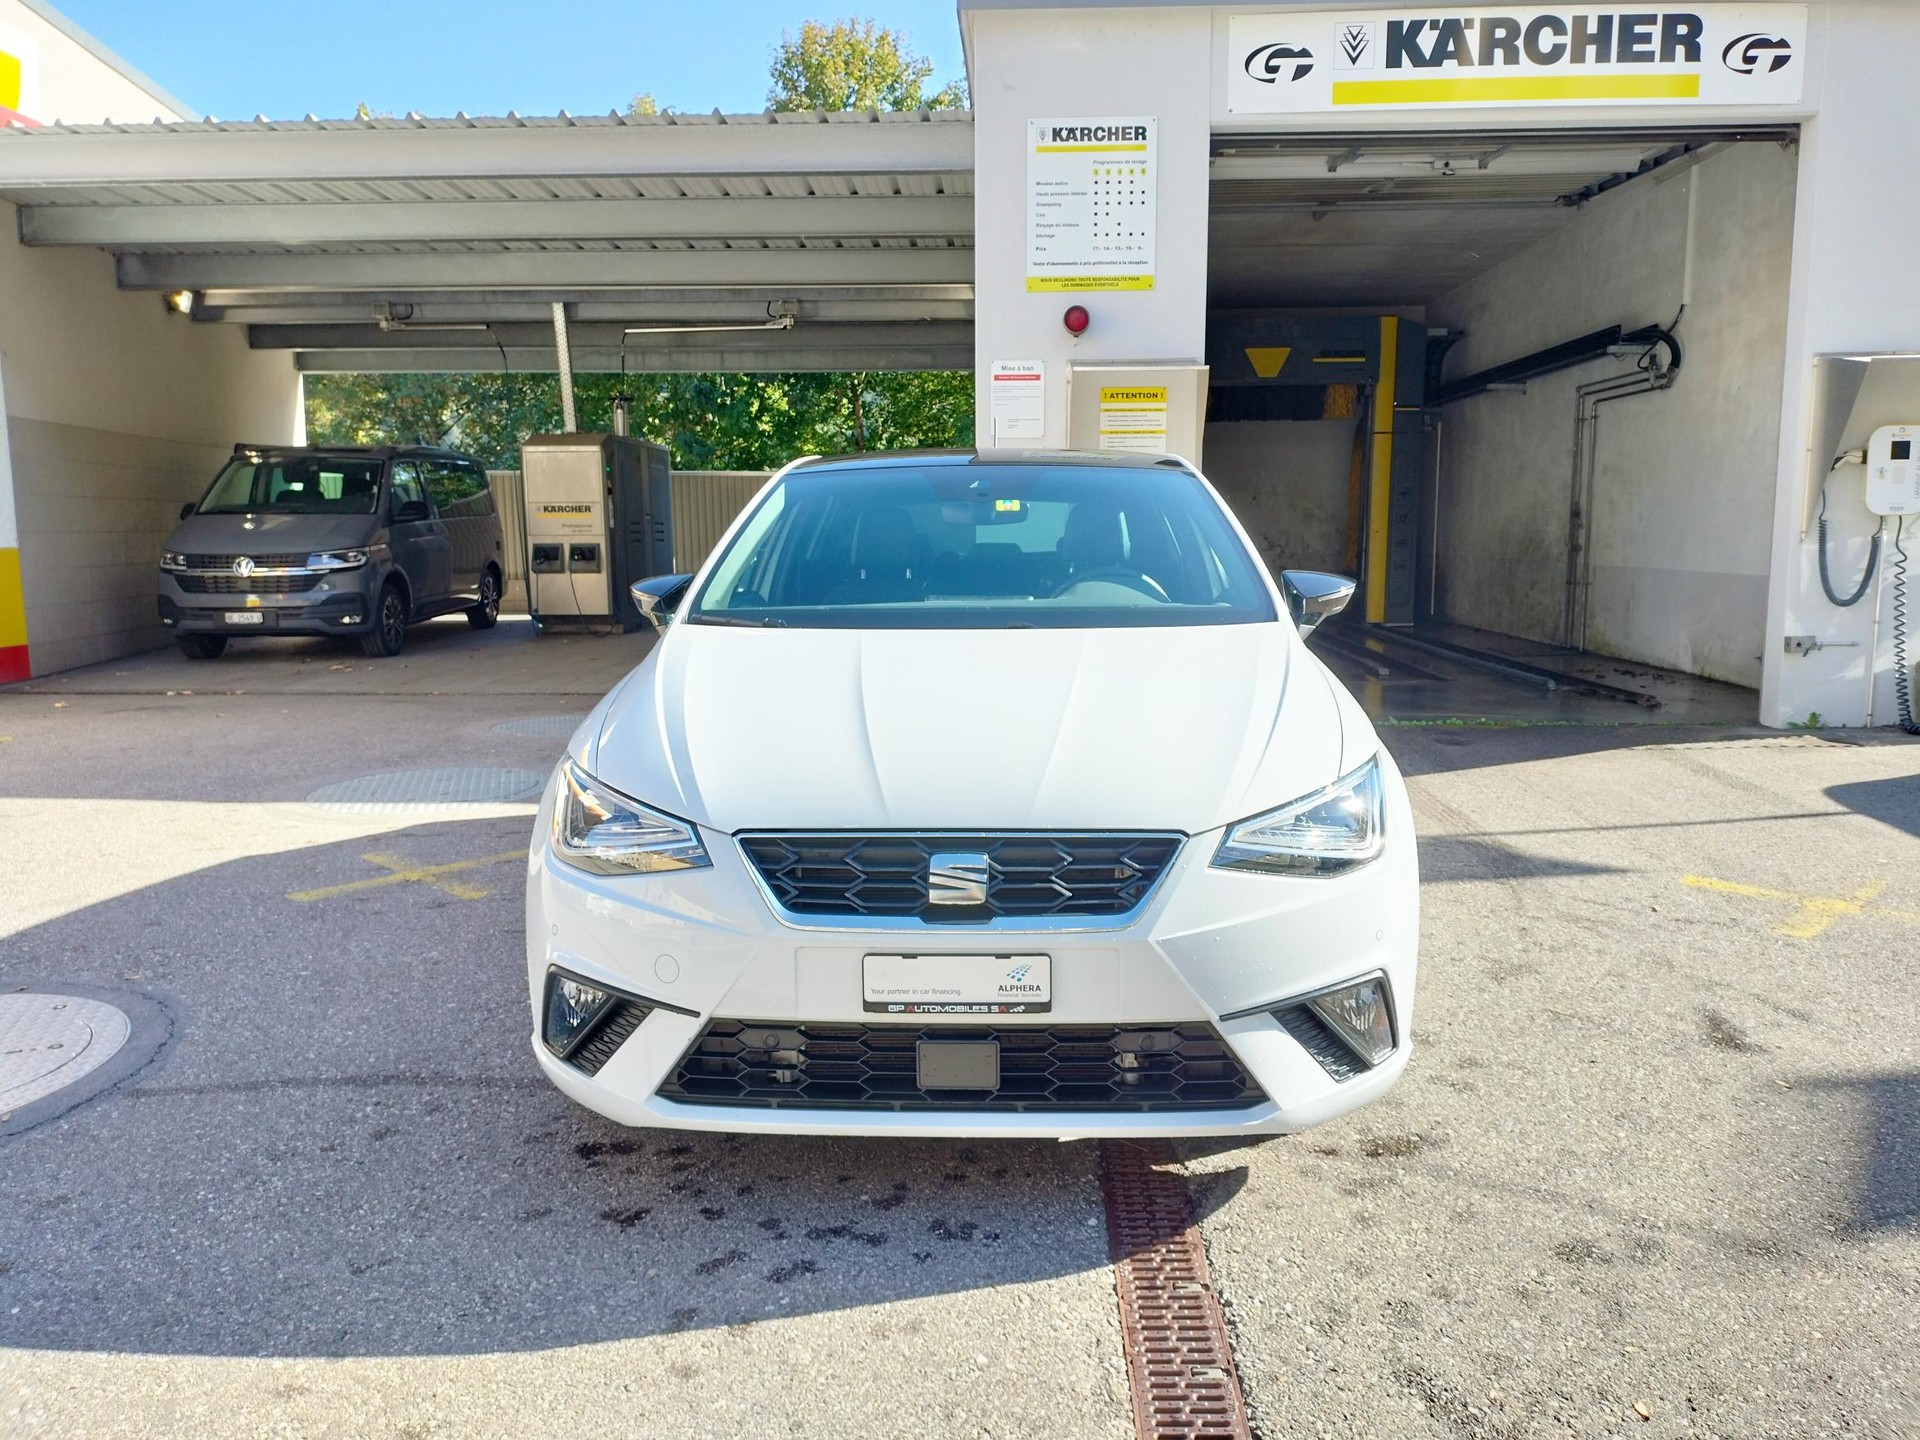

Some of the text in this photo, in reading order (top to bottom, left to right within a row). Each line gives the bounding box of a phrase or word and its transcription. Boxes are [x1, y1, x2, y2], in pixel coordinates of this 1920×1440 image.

[1385, 13, 1704, 69] KÄRCHER
[1052, 125, 1148, 142] KÄRCHER
[887, 988, 911, 996] partner
[998, 984, 1042, 992] ALPHERA
[905, 1004, 989, 1013] AUTOMOBILES
[990, 1005, 1009, 1013] SA
